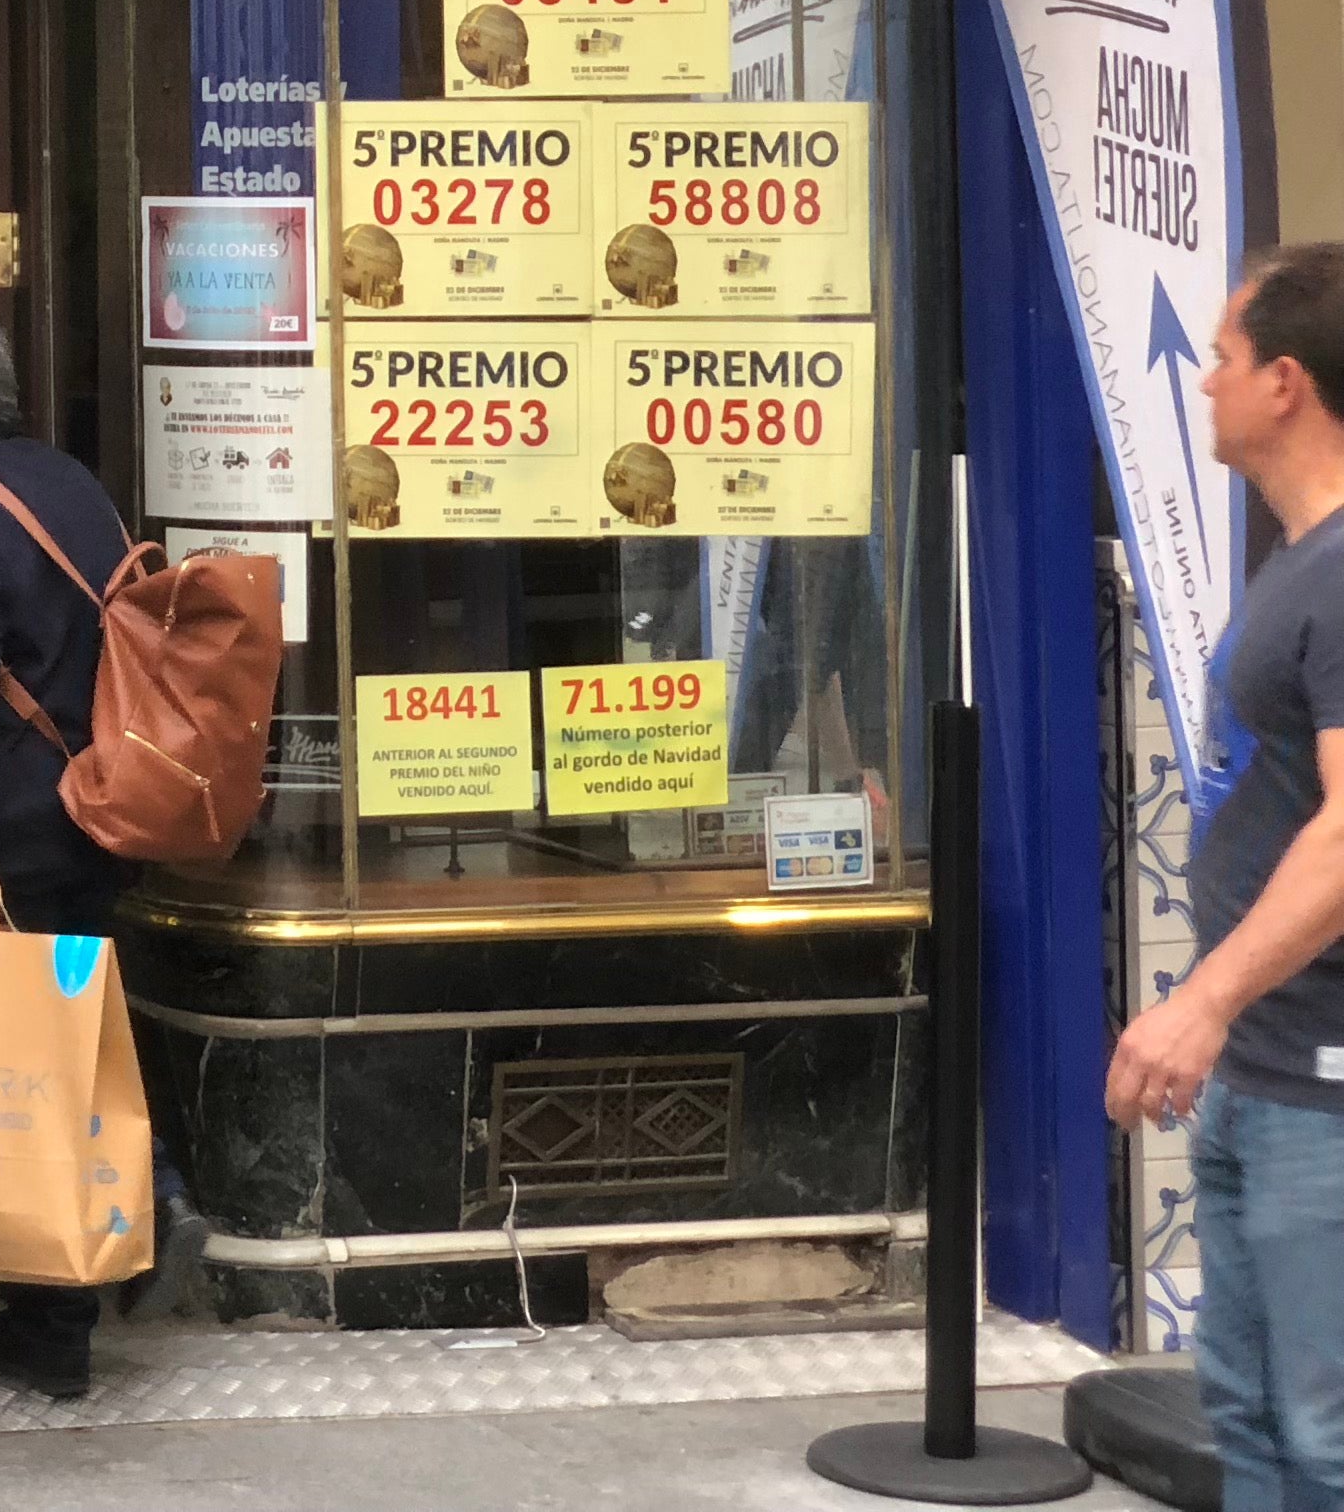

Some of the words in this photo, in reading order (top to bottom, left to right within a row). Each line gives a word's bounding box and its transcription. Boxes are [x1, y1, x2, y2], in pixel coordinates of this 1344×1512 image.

[201, 74, 321, 103] Loterías
[390, 128, 571, 168] PREMIO
[664, 129, 840, 169] PREMIO
[201, 164, 301, 194] Estado
[372, 177, 552, 227] 03278
[648, 178, 823, 227] 58808
[166, 242, 279, 258] VACACIONES
[199, 270, 218, 289] LA
[224, 270, 276, 290] VENTA
[274, 319, 293, 329] 20€
[387, 349, 569, 389] PREMIO
[664, 349, 844, 389] PREMIO
[369, 398, 550, 448] 22253
[646, 397, 824, 447] 00580
[212, 537, 240, 547] SIGUE
[241, 537, 249, 546] A
[382, 683, 502, 723] 18441
[560, 672, 702, 716] 71.199
[560, 724, 633, 744] Número
[637, 720, 713, 744] posterior
[372, 748, 435, 762] ANTERIOR
[438, 747, 454, 760] AL
[456, 745, 518, 759] SEGUNDO
[553, 753, 570, 770] al
[573, 751, 625, 773] gordo
[627, 749, 649, 768] de
[653, 745, 722, 766] Navidad
[389, 766, 443, 780] PREMIO
[443, 765, 464, 778] DEL
[468, 763, 502, 777] NIÑO
[583, 775, 654, 795] vendido
[657, 771, 695, 796] aquí
[398, 784, 456, 798] VENDIDO
